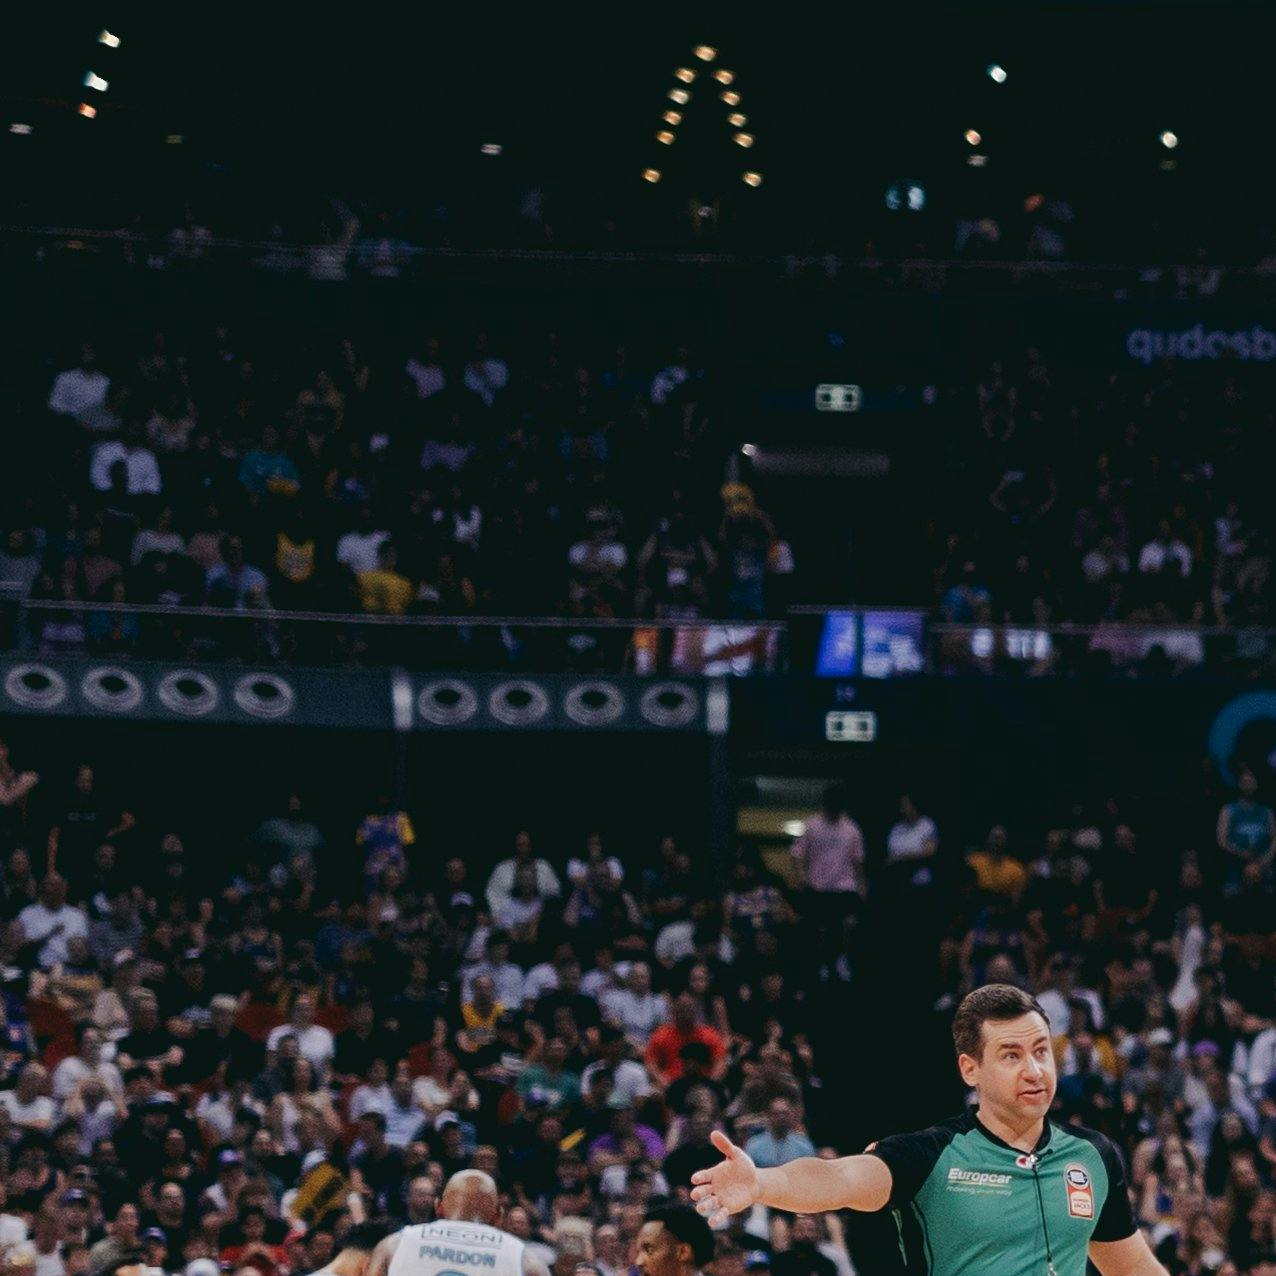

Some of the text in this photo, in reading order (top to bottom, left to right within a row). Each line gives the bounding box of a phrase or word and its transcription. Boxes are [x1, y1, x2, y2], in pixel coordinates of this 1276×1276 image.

[948, 1168, 1013, 1185] Europcar
[429, 1228, 495, 1243] NEON
[419, 1245, 496, 1268] PARDON
